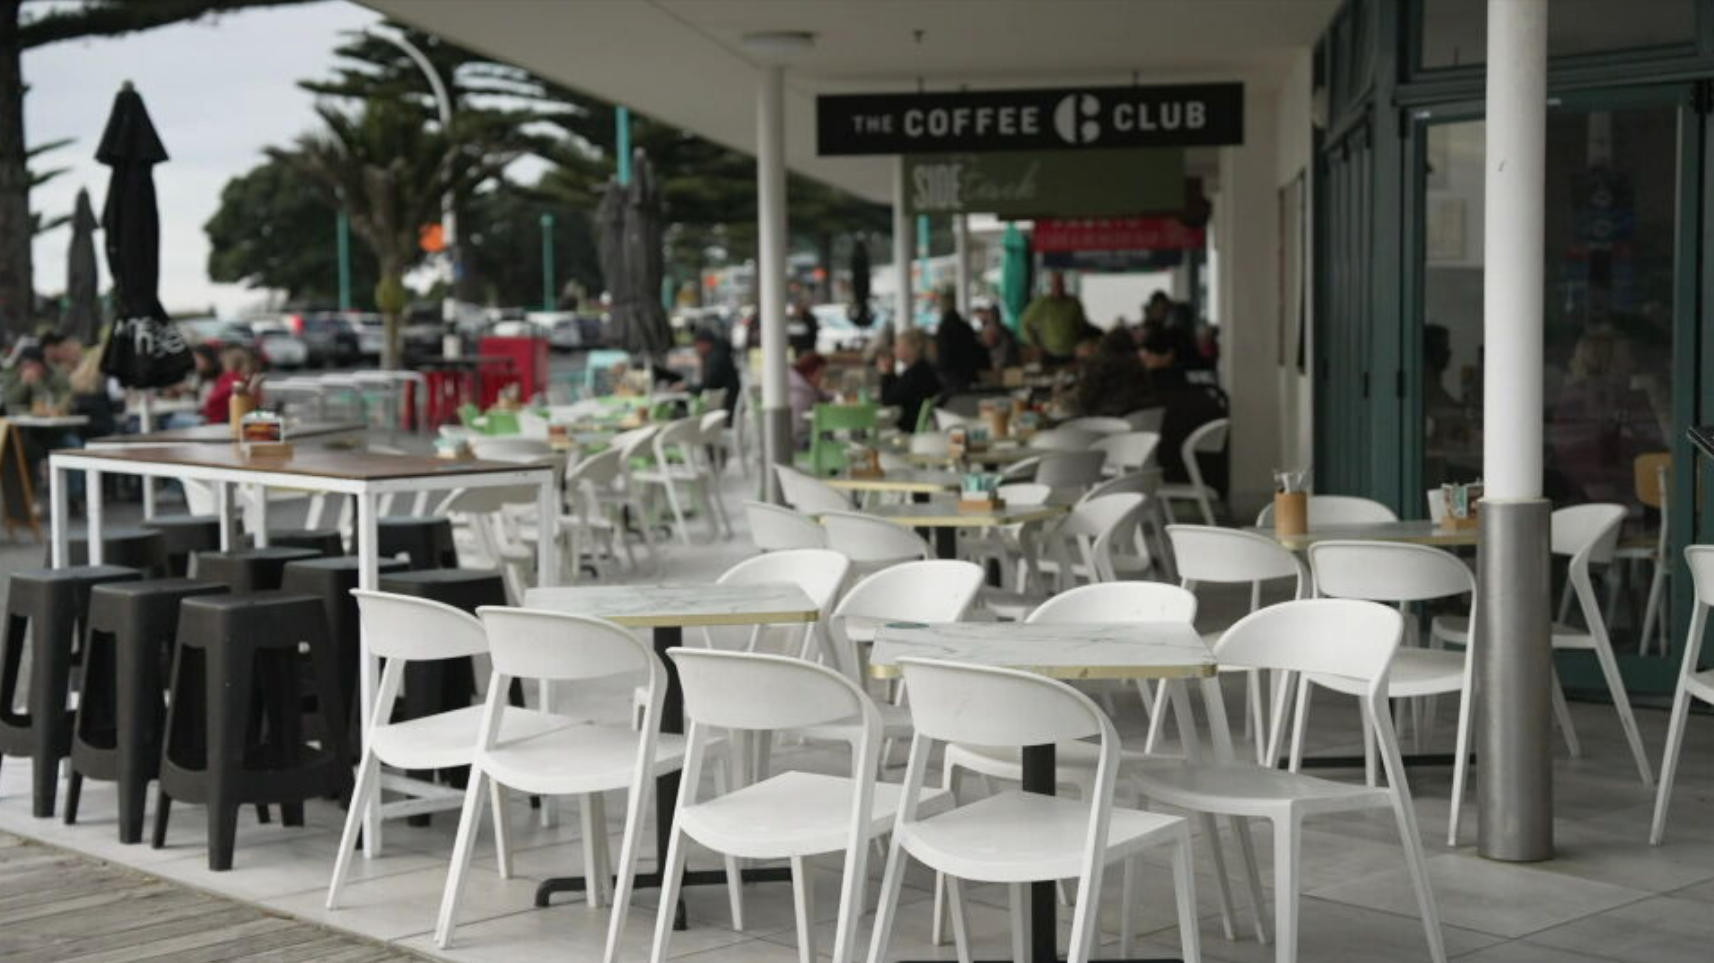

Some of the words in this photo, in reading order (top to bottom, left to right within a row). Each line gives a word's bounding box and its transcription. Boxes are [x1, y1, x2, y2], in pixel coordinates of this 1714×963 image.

[853, 115, 895, 134] THE
[904, 106, 1041, 136] COFFEE
[1113, 101, 1206, 131] CLUB
[913, 163, 962, 210] SIDE
